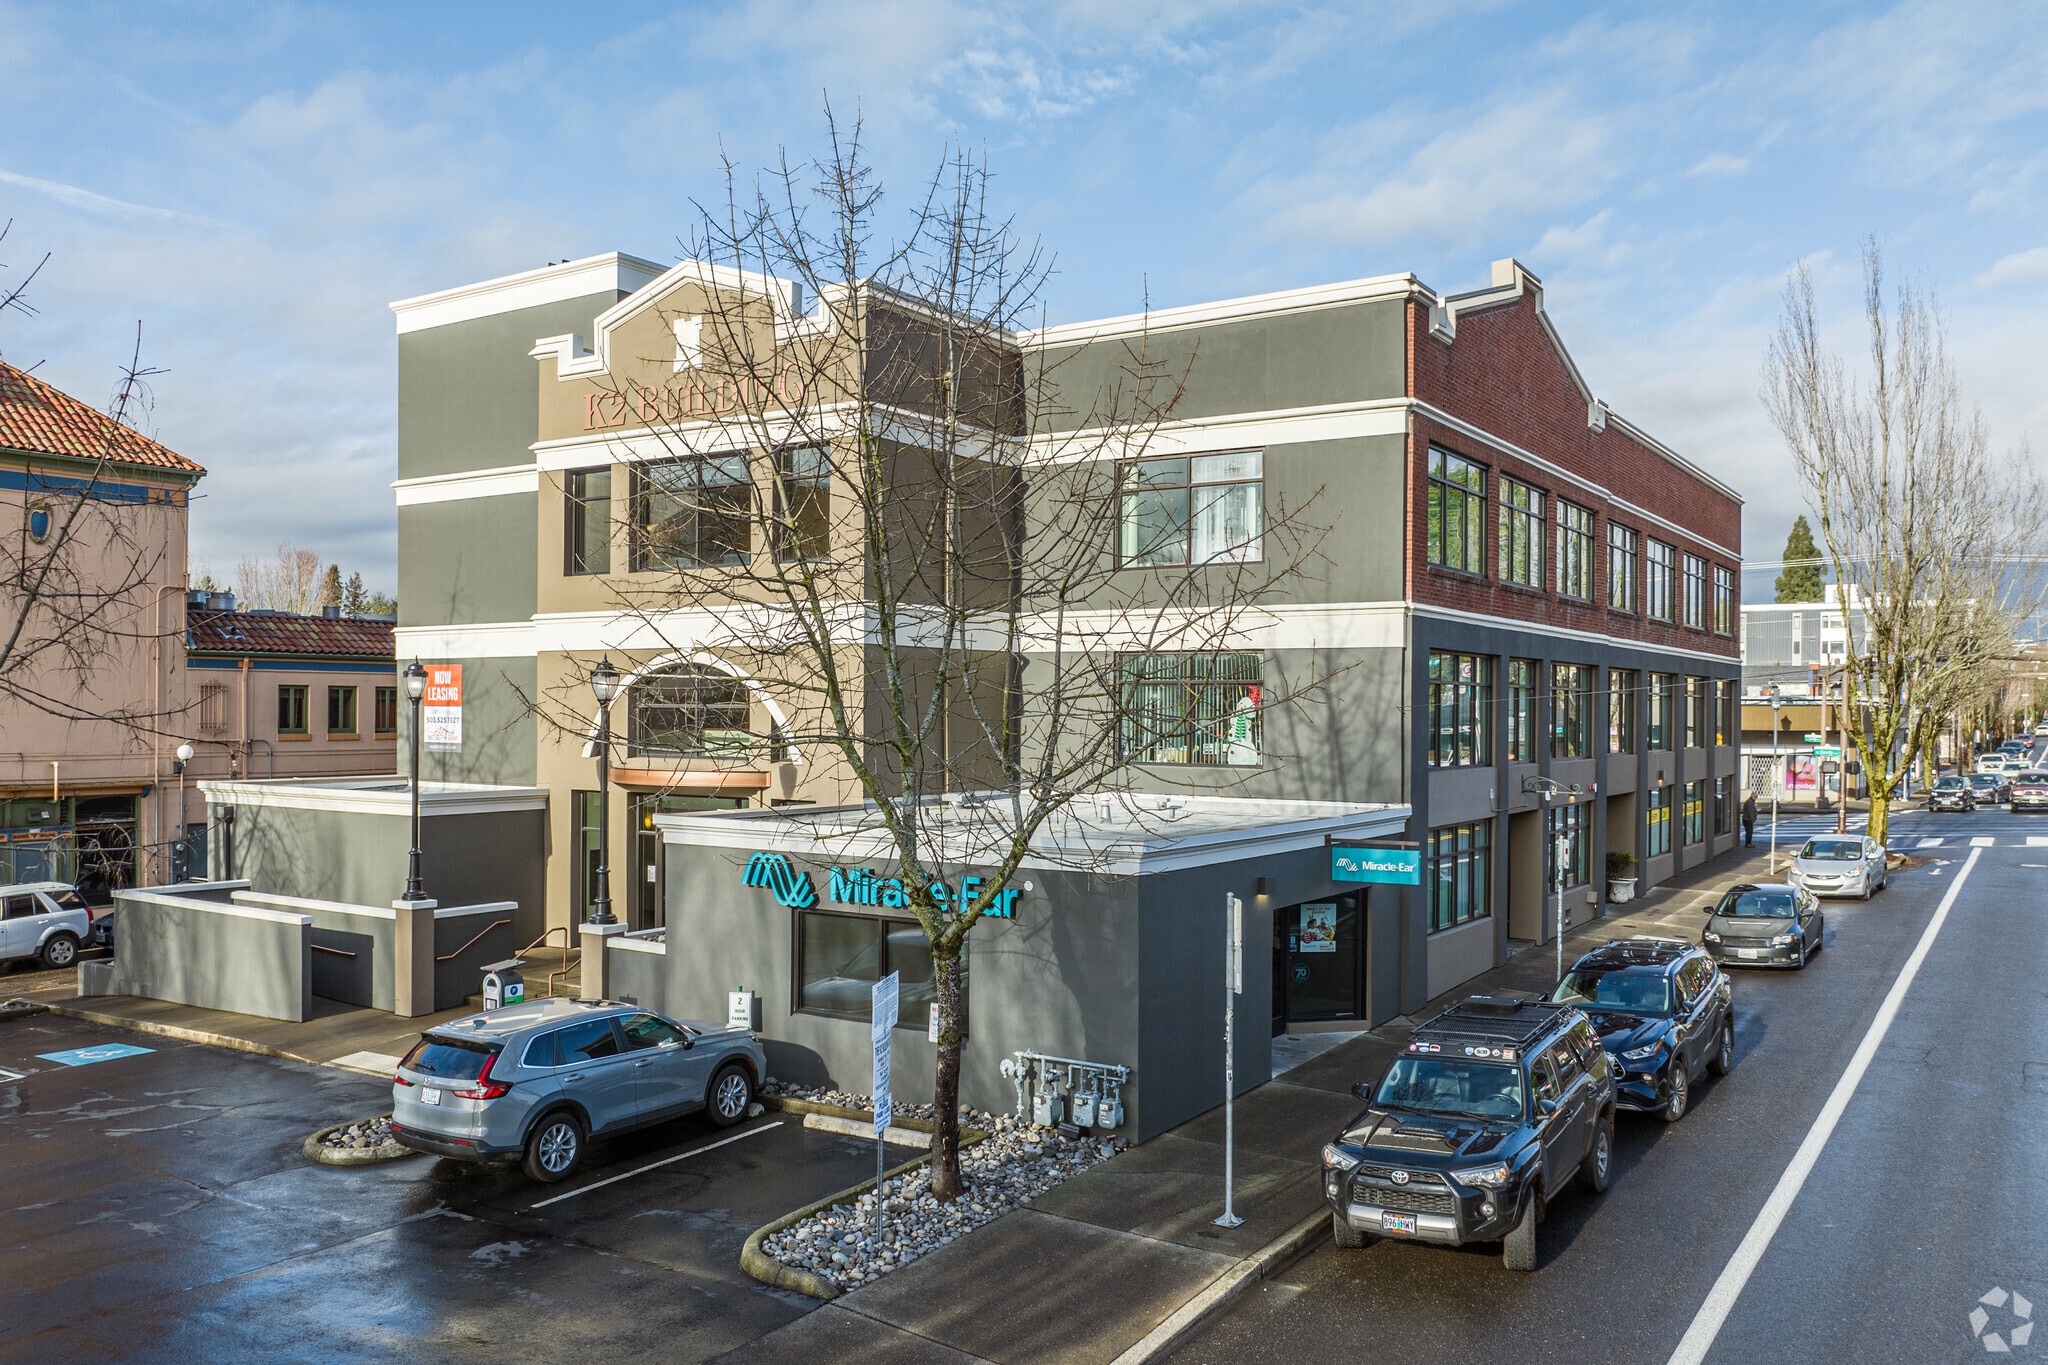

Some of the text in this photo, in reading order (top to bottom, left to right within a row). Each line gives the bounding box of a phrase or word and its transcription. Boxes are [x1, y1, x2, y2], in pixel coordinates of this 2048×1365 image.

[583, 360, 804, 431] K2 BUILDING
[434, 670, 452, 685] NOW
[427, 686, 459, 701] LEASING
[1362, 860, 1415, 873] Miracle-Ear
[829, 865, 1019, 919] Mirae-Ear
[1295, 968, 1307, 978] 70
[738, 997, 743, 1005] 2
[1383, 1217, 1414, 1230] 896 HWY
